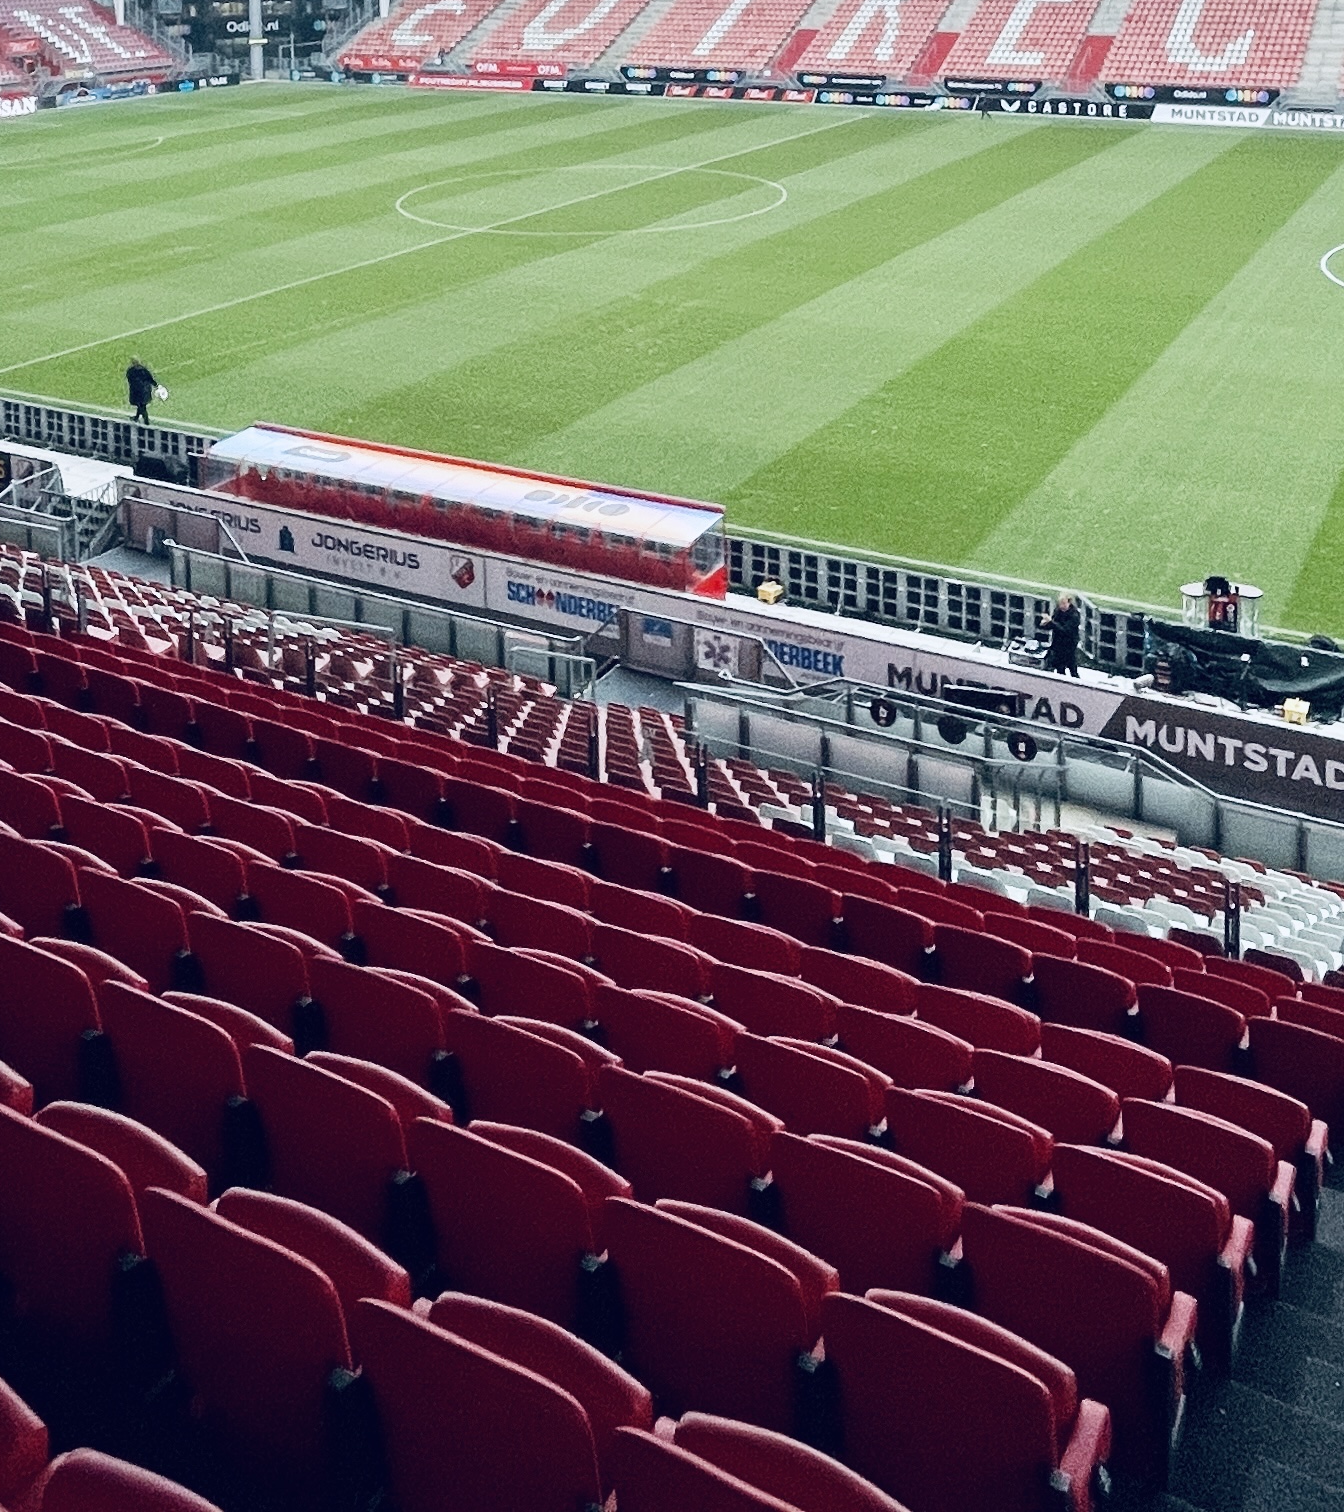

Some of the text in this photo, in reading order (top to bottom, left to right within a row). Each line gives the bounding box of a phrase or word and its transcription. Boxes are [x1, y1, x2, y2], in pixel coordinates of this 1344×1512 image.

[1027, 99, 1128, 119] CASTORE
[1171, 108, 1259, 125] MUNTSTAD
[311, 532, 420, 570] JONGERIUS
